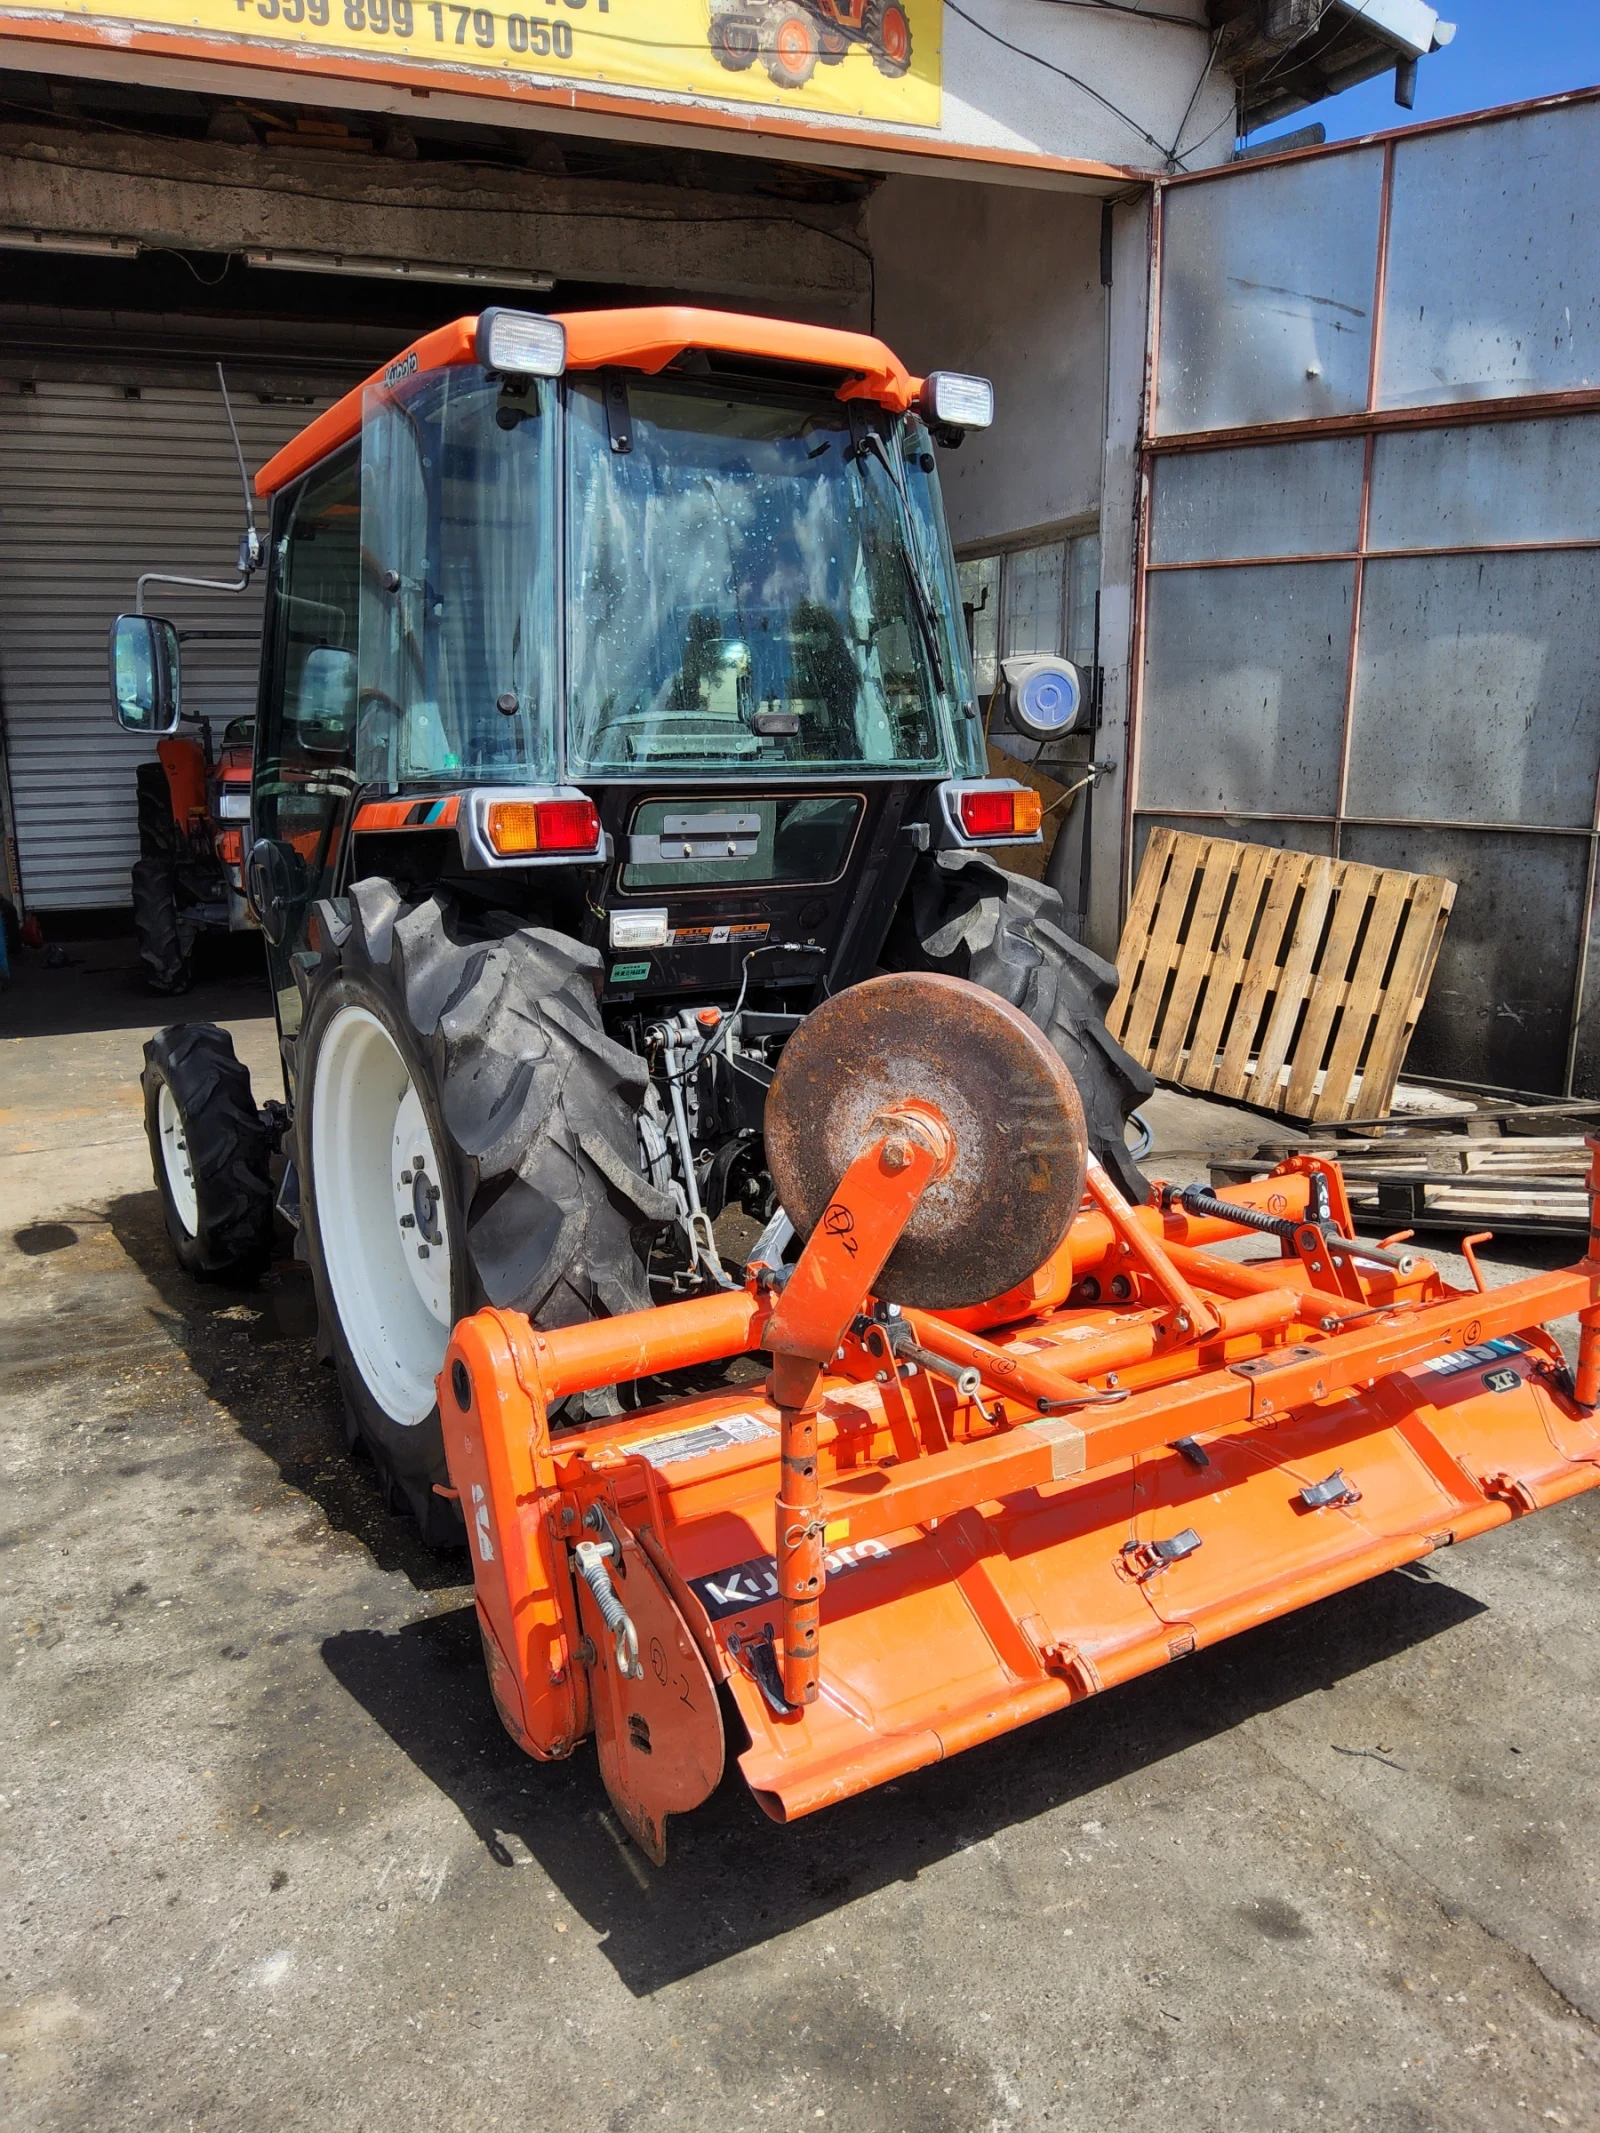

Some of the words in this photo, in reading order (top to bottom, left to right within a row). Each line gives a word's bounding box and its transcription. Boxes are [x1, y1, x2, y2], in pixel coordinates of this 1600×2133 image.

[343, 0, 414, 38] 899
[427, 2, 495, 48] 179
[507, 13, 573, 59] 050
[1488, 1370, 1515, 1392] XF
[704, 1539, 892, 1605] Kuta
